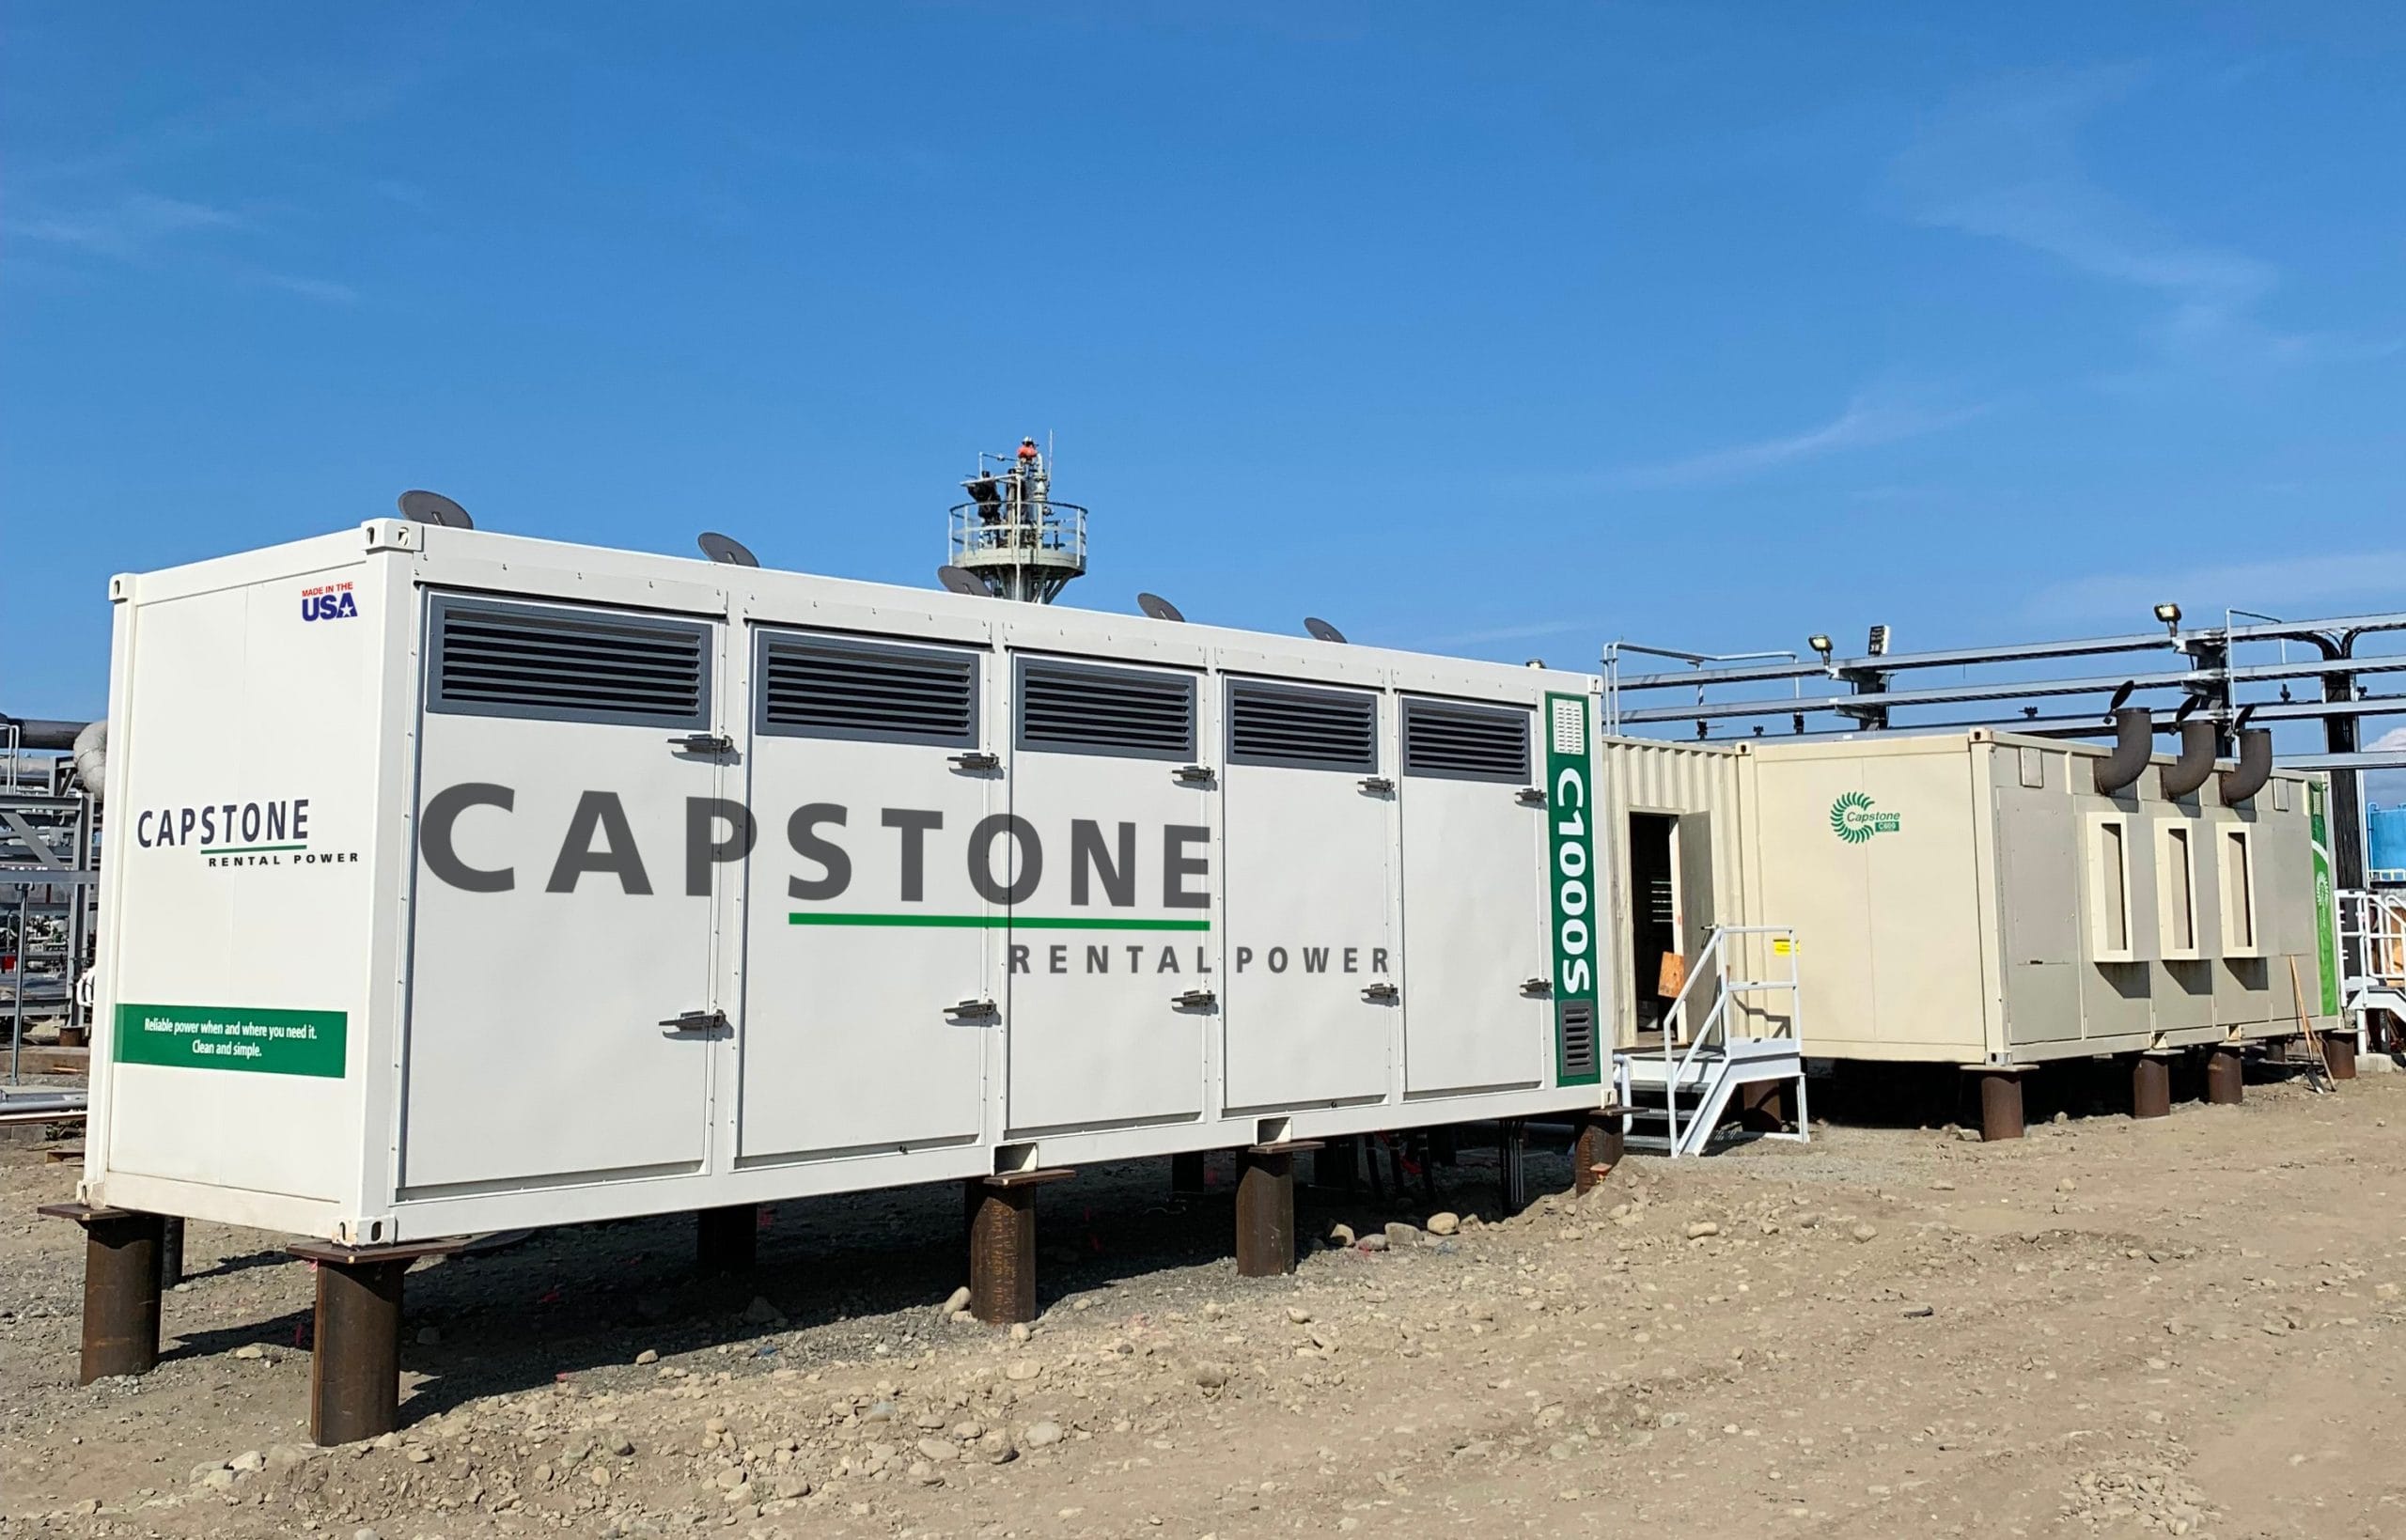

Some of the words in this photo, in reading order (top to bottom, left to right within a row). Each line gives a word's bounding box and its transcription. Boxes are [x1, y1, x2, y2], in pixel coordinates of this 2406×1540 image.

[302, 586, 323, 597] MADE
[336, 582, 353, 591] THE
[302, 592, 358, 622] USA
[137, 799, 309, 848] CAPSTONE
[1847, 812, 1900, 823] Capstone
[419, 782, 1211, 910] CAPSTONE
[209, 856, 280, 867] RENTAL
[294, 852, 358, 864] POWER
[1557, 768, 1590, 994] C1000S
[1008, 944, 1212, 974] RENTAL
[1236, 946, 1389, 974] POWER
[145, 1018, 173, 1032] Reliable
[174, 1022, 199, 1035] power
[201, 1019, 223, 1034] when
[225, 1020, 241, 1035] and
[242, 1021, 268, 1036] where
[269, 1026, 285, 1040] you
[286, 1024, 306, 1038] need
[308, 1024, 318, 1039] it.
[193, 1039, 214, 1054] Clean
[216, 1041, 232, 1055] and
[233, 1042, 262, 1060] simple.
